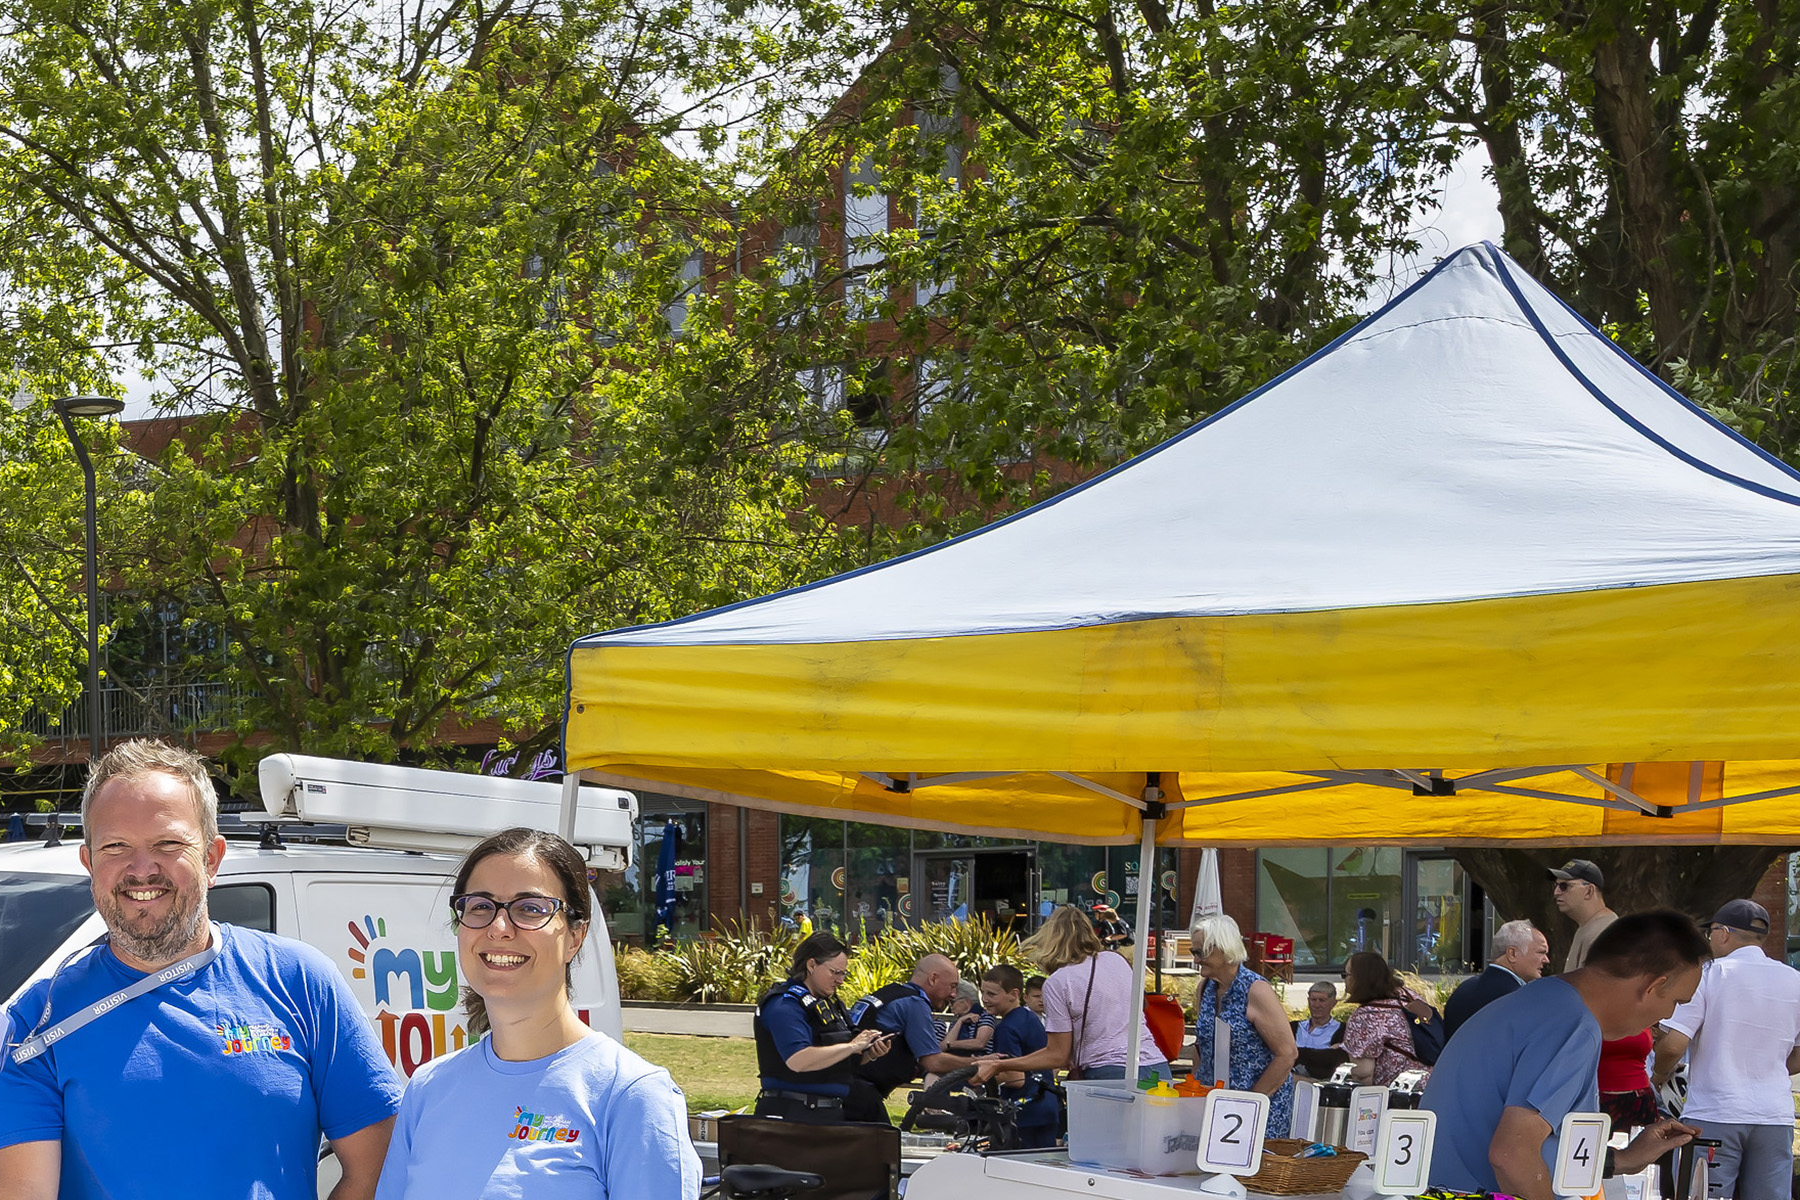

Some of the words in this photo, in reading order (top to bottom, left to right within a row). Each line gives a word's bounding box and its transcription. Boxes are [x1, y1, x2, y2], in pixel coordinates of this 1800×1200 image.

[159, 961, 195, 983] VISITOR
[372, 948, 459, 1011] my
[93, 992, 129, 1015] VISITOR
[1220, 1113, 1244, 1144] 2
[1394, 1134, 1413, 1166] 3
[1572, 1137, 1590, 1167] 4
